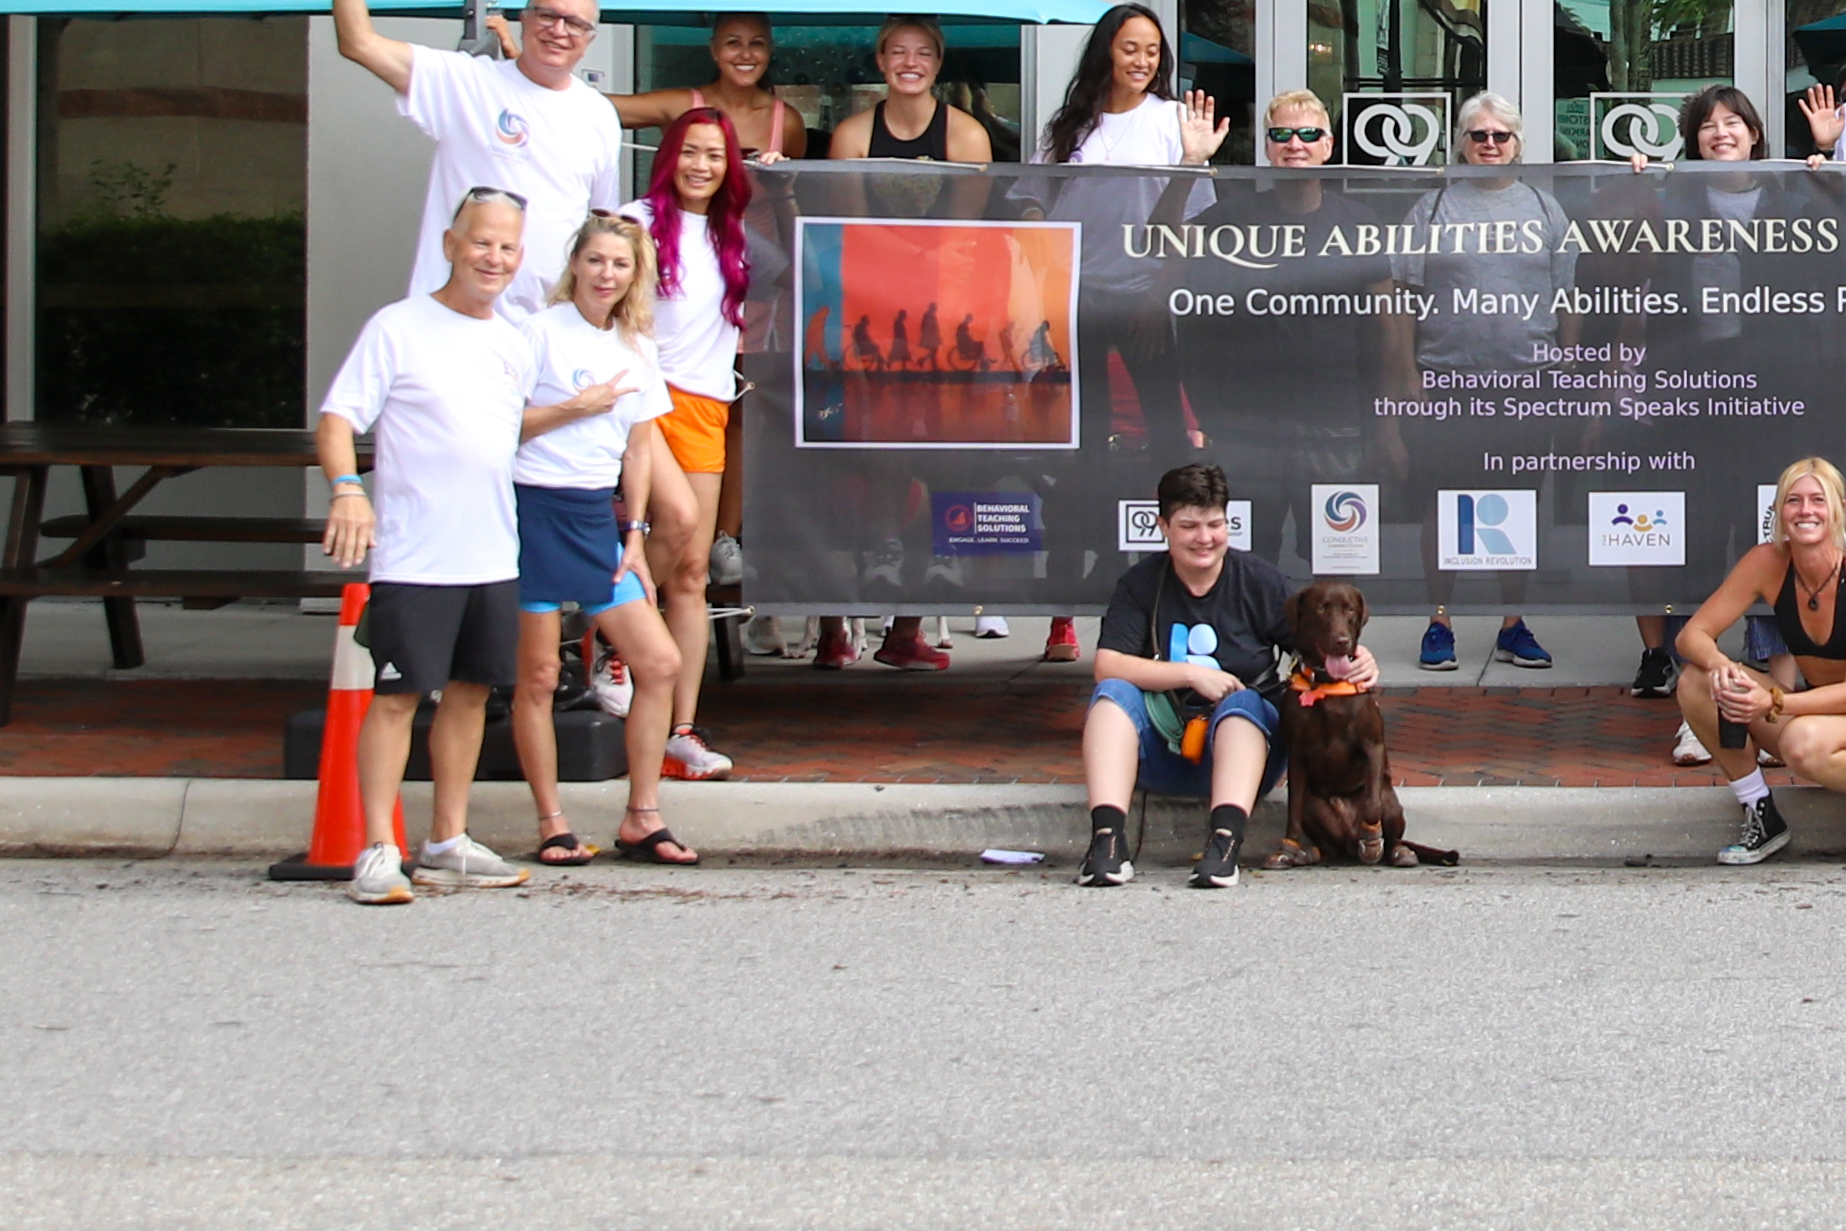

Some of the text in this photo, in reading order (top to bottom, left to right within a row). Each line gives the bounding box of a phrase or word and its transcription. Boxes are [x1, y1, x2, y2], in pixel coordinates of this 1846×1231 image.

[1354, 103, 1440, 166] 99
[1121, 223, 1306, 269] UNIQUE
[1318, 218, 1544, 257] ABILITIES
[1556, 217, 1840, 256] AWARENESS
[1169, 288, 1236, 316] One
[1246, 287, 1440, 321] Community.
[1453, 288, 1541, 322] Many
[1549, 286, 1689, 315] Abilities.
[1702, 285, 1826, 314] Endless
[1532, 342, 1646, 366] Hosted by
[1422, 369, 1757, 393] Behavioral Teaching Solutions
[1374, 396, 1806, 421] through its Spectrum Speaks Initiative
[1484, 450, 1696, 475] In partnership with
[976, 504, 1031, 514] BEHAVIORAL
[977, 514, 1021, 523] TEACHING
[977, 524, 1028, 533] SOLUTIONS
[1132, 510, 1158, 537] 99
[1608, 533, 1671, 547] HAVEN
[1443, 555, 1533, 566] INCLUSION REVOLUTION
